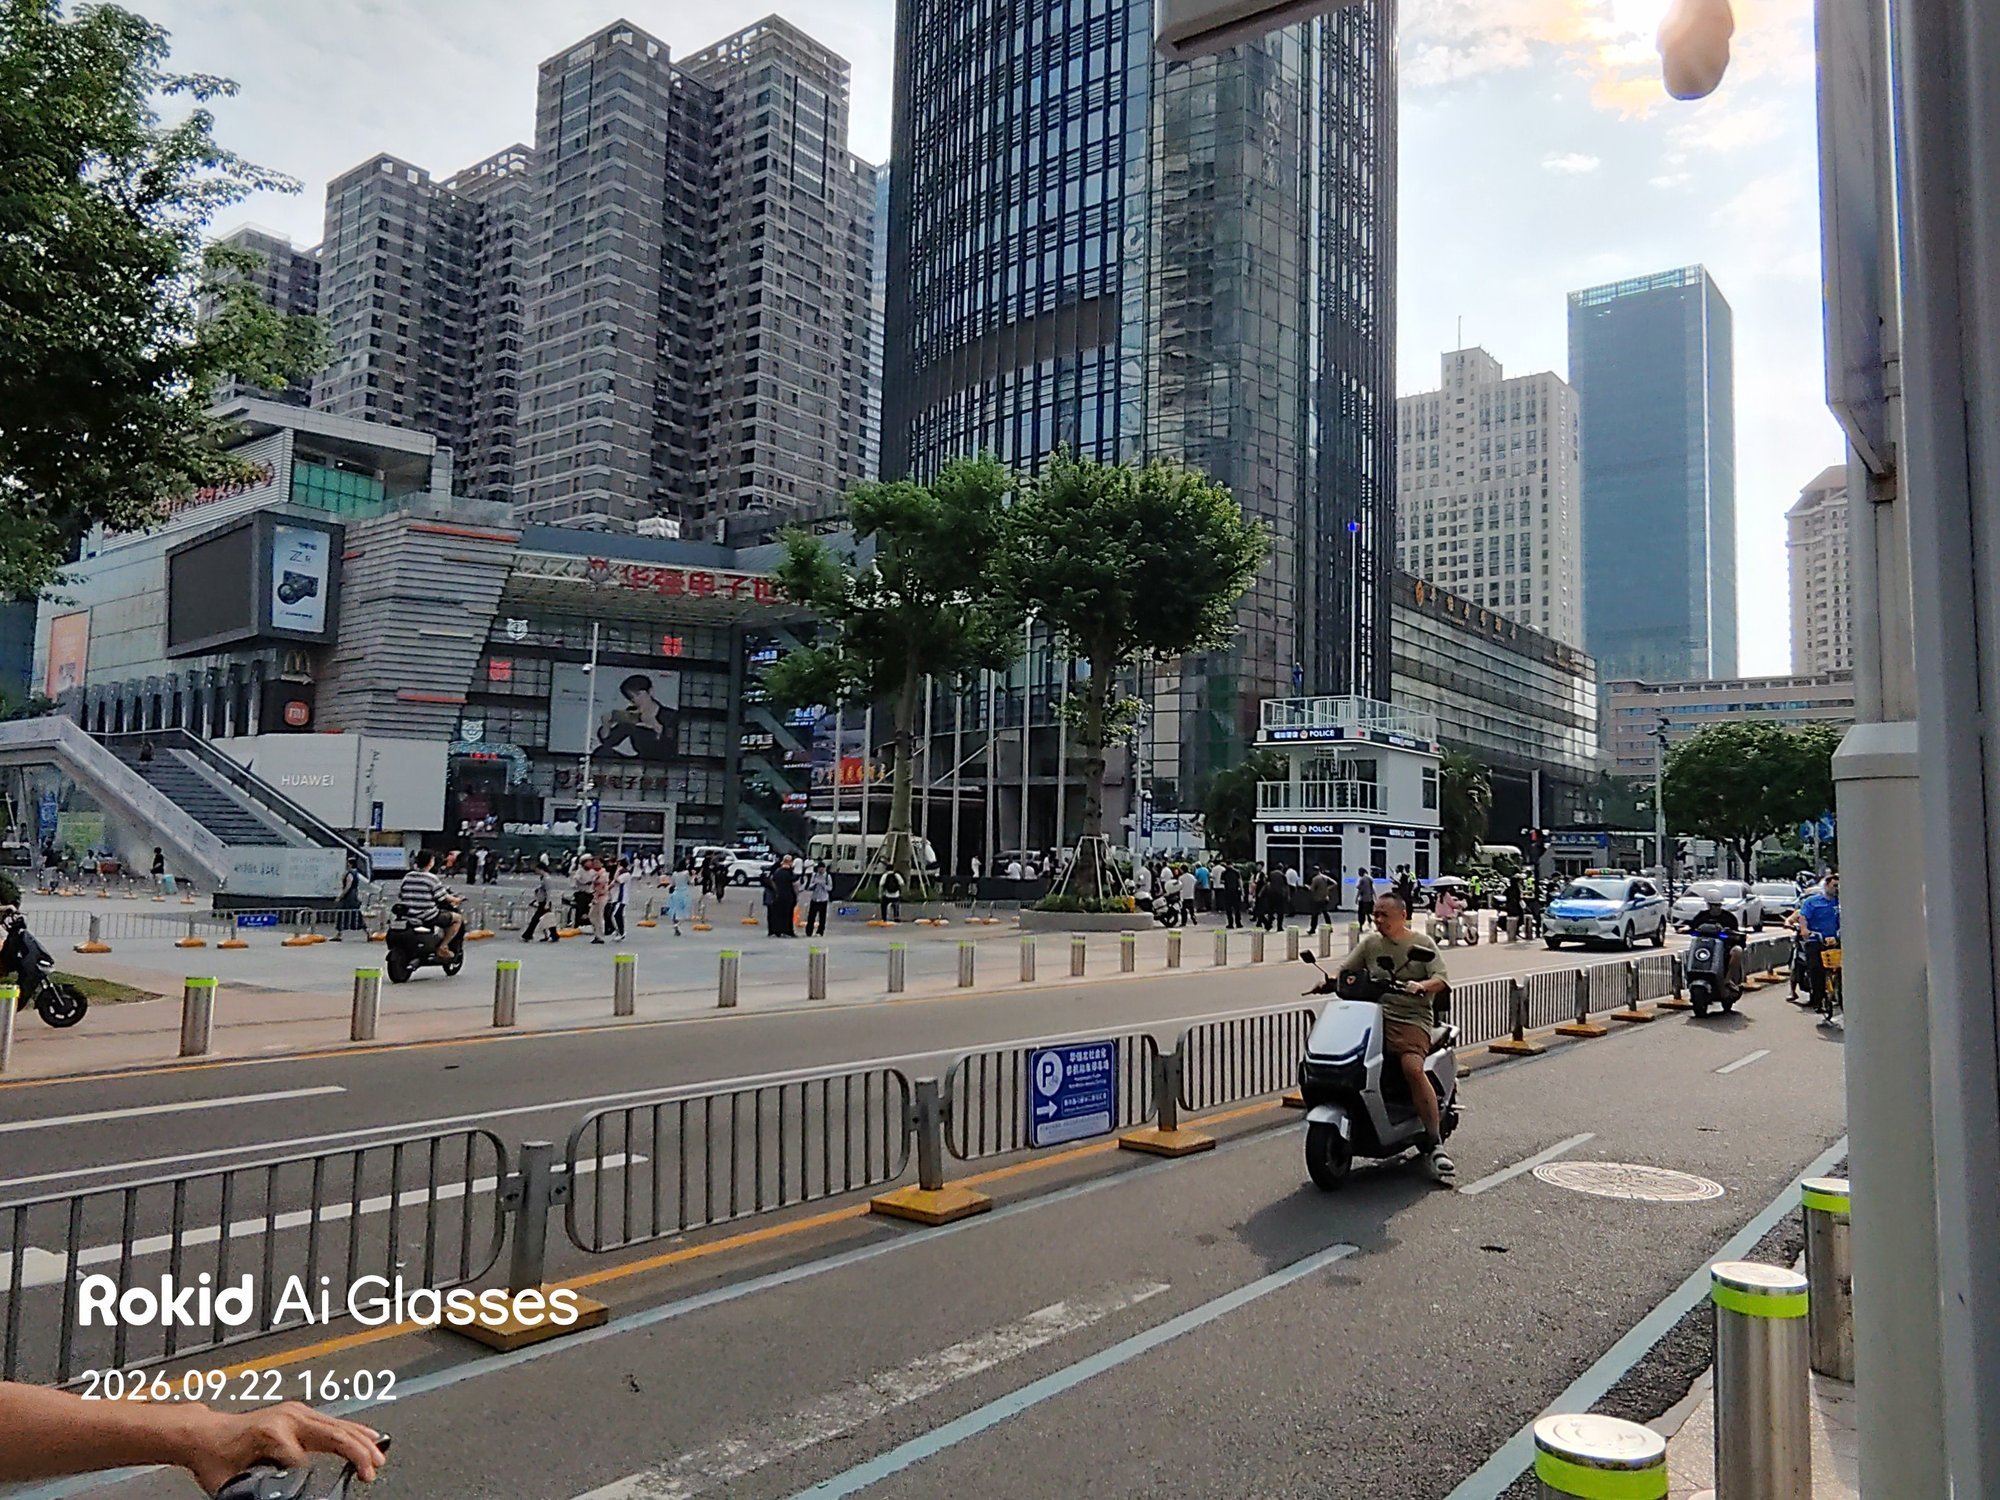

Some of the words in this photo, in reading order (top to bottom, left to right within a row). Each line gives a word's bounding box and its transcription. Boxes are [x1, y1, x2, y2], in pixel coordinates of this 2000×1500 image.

[1309, 729, 1335, 738] POLICE
[281, 774, 335, 787] HUAWEI
[1308, 825, 1334, 833] POLICE
[1042, 1061, 1055, 1089] P
